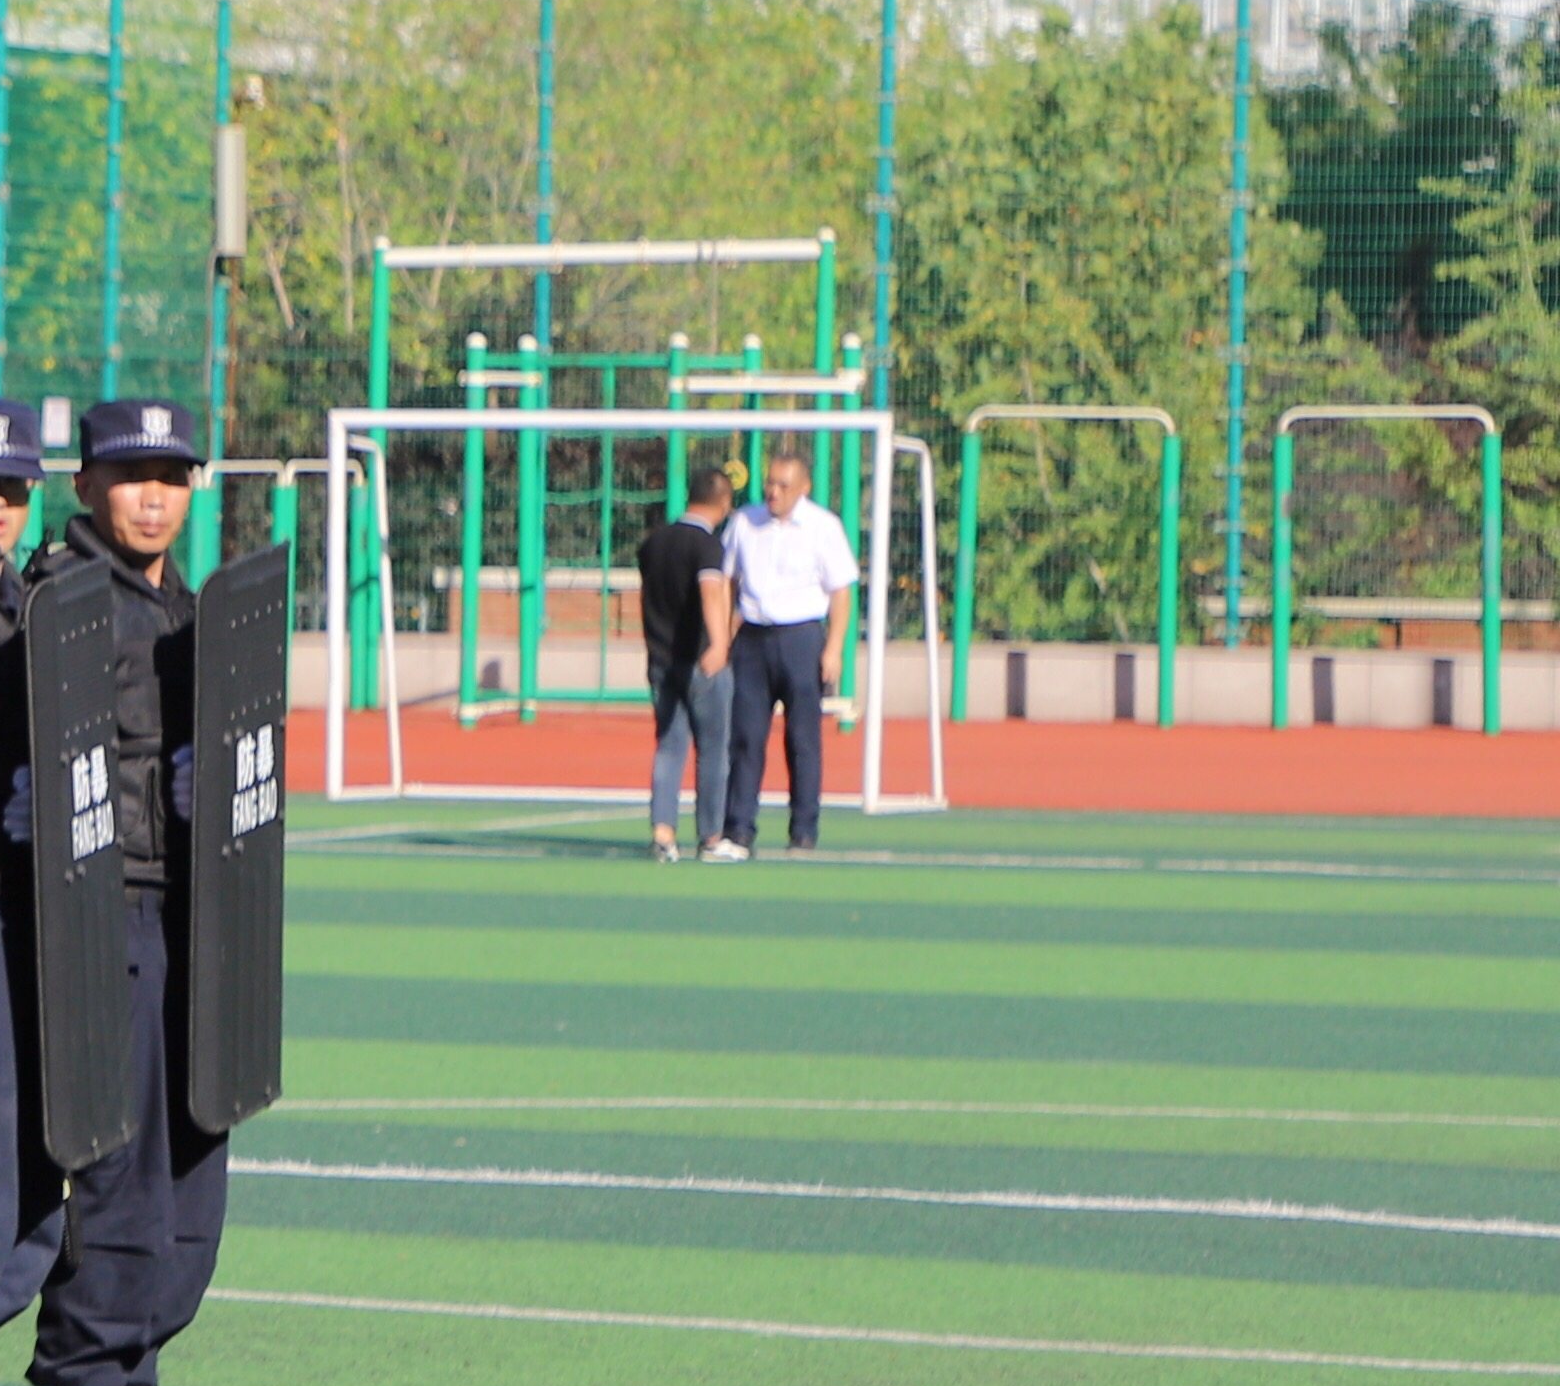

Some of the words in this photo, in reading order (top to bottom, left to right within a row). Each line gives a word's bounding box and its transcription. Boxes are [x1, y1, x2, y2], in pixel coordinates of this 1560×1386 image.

[72, 744, 109, 814] 防暴
[236, 723, 275, 792] 防暴
[72, 808, 96, 861] FANG
[95, 800, 115, 851] BAO
[232, 784, 258, 837] FANG
[257, 777, 278, 825] BAO
